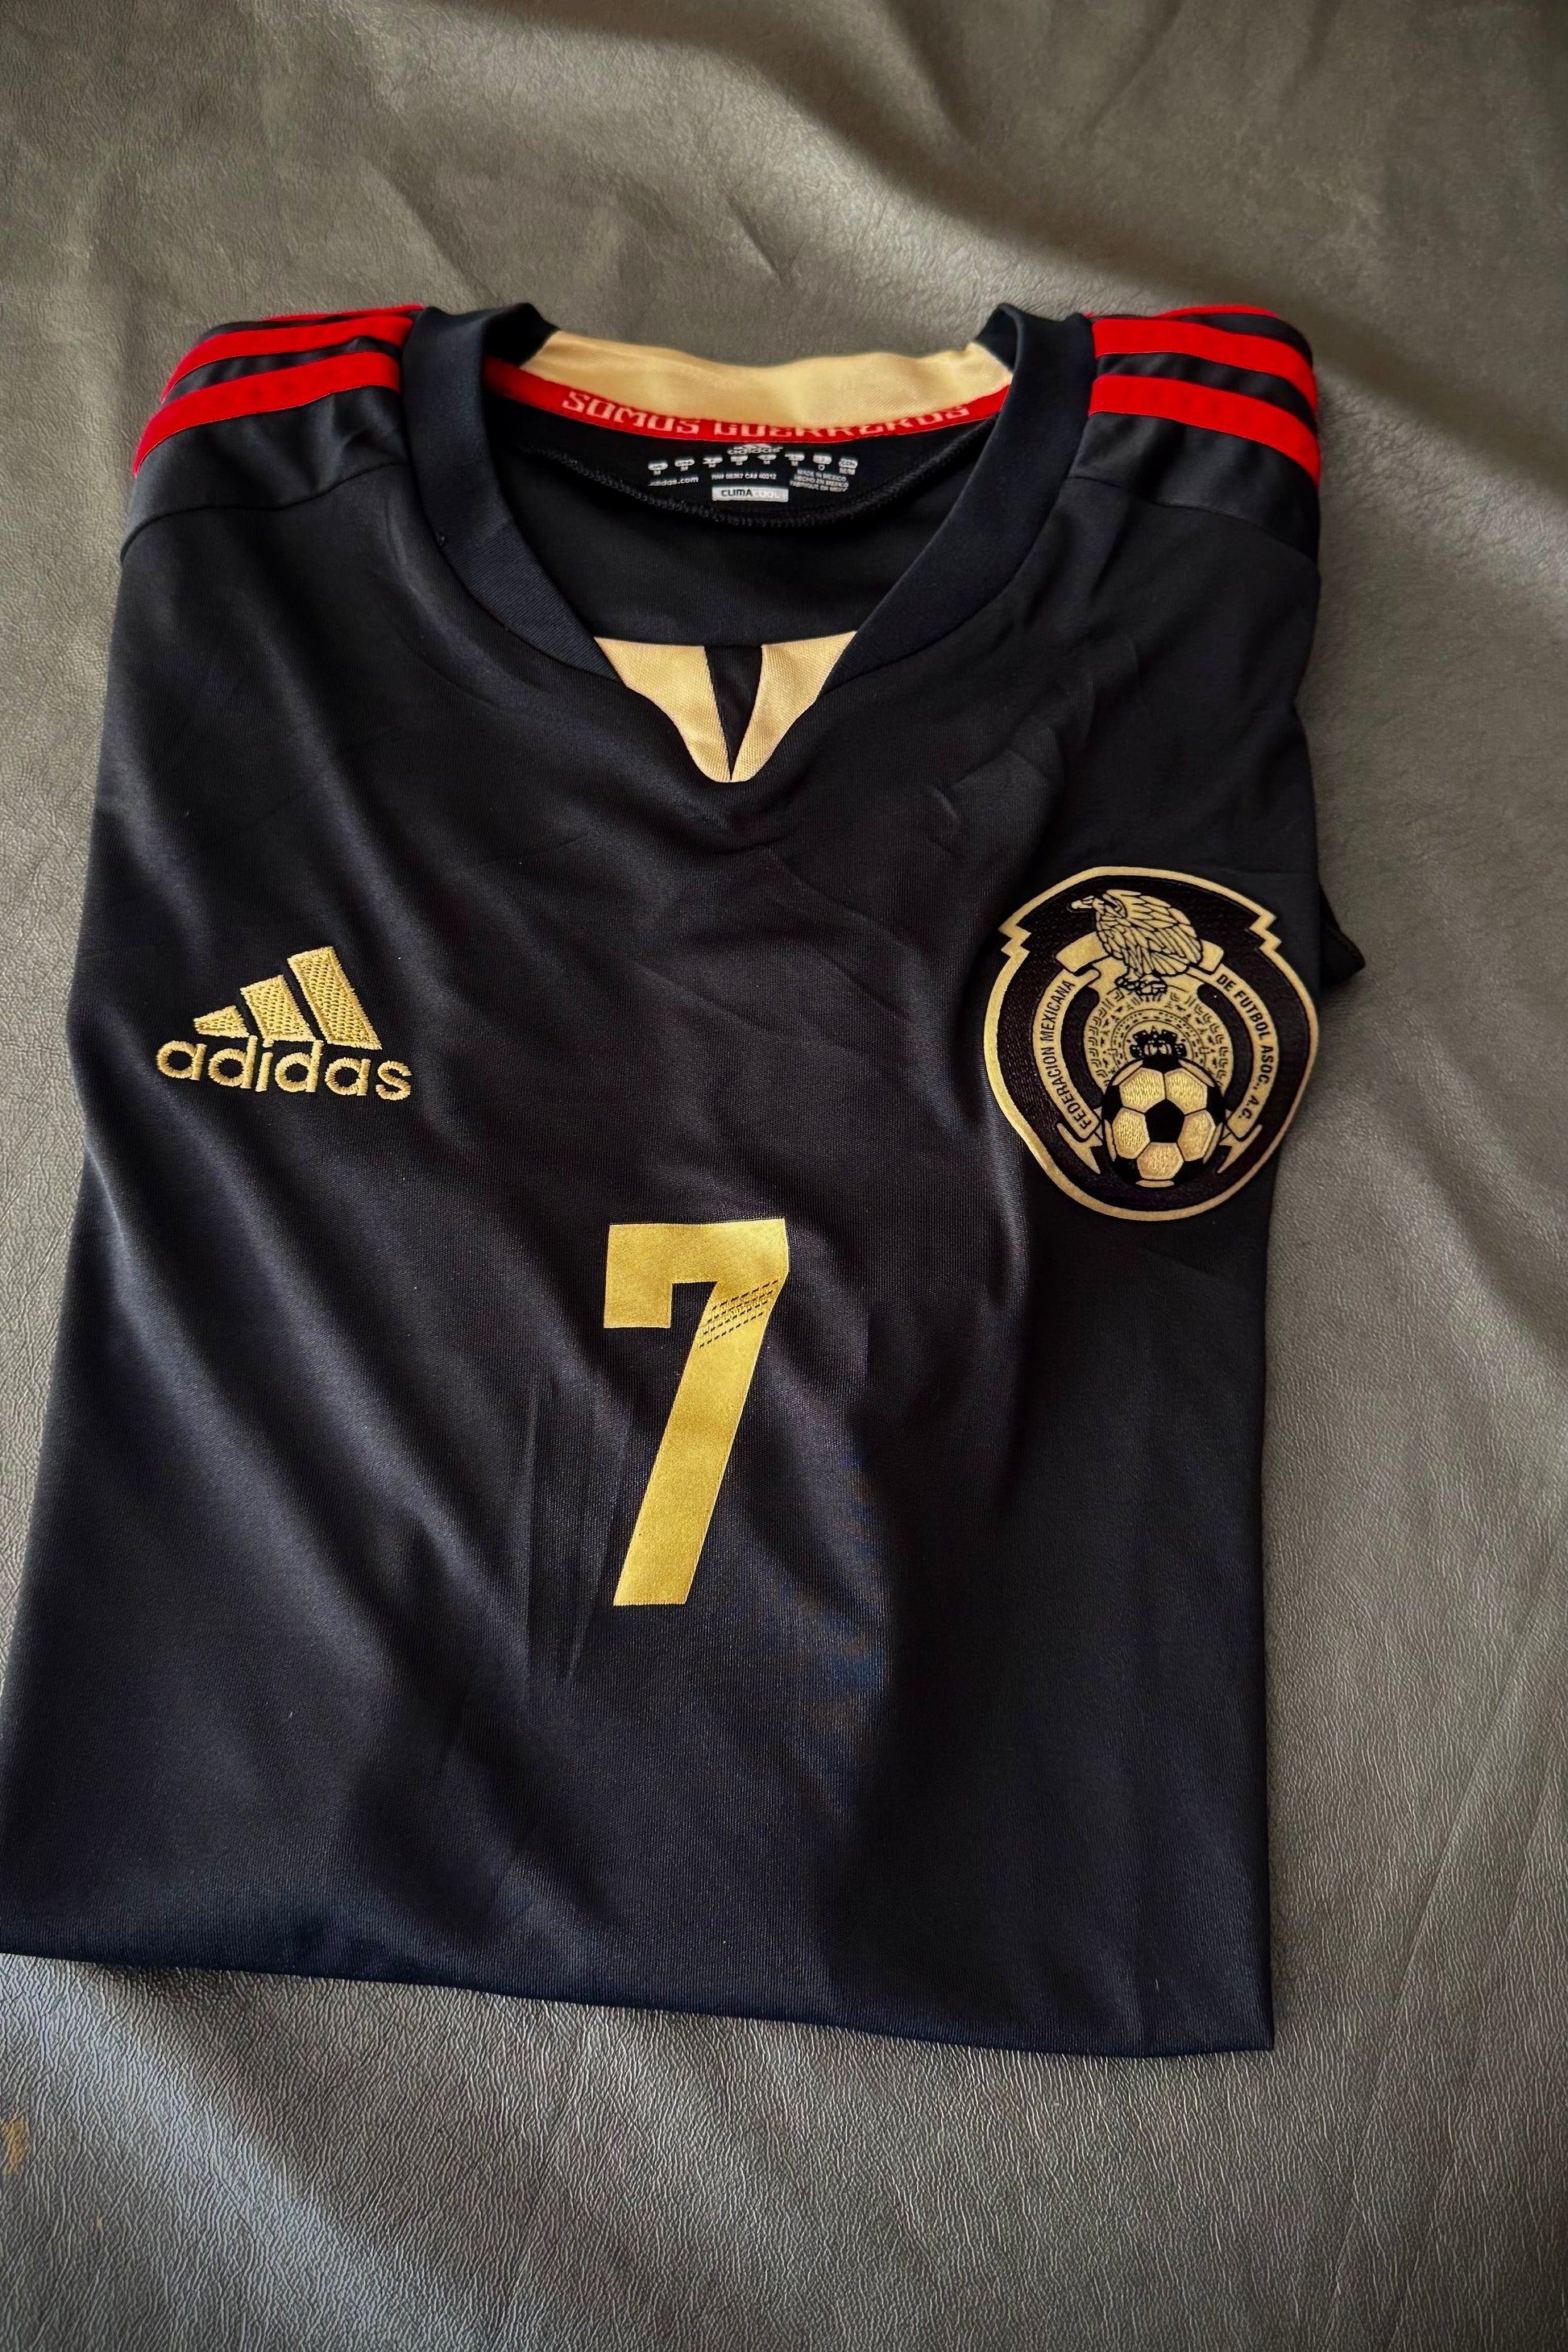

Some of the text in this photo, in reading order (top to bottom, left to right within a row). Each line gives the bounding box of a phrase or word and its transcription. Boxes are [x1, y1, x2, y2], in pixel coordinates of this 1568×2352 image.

[562, 391, 970, 438] SOMOS GUERREROS
[1216, 974, 1236, 992] DE
[1234, 990, 1270, 1040] FUTBOL
[156, 1035, 412, 1101] adidas
[1039, 980, 1092, 1130] FEDERACION MEXICANA
[1238, 1095, 1260, 1119] A.C.
[604, 1217, 790, 1606] 7
